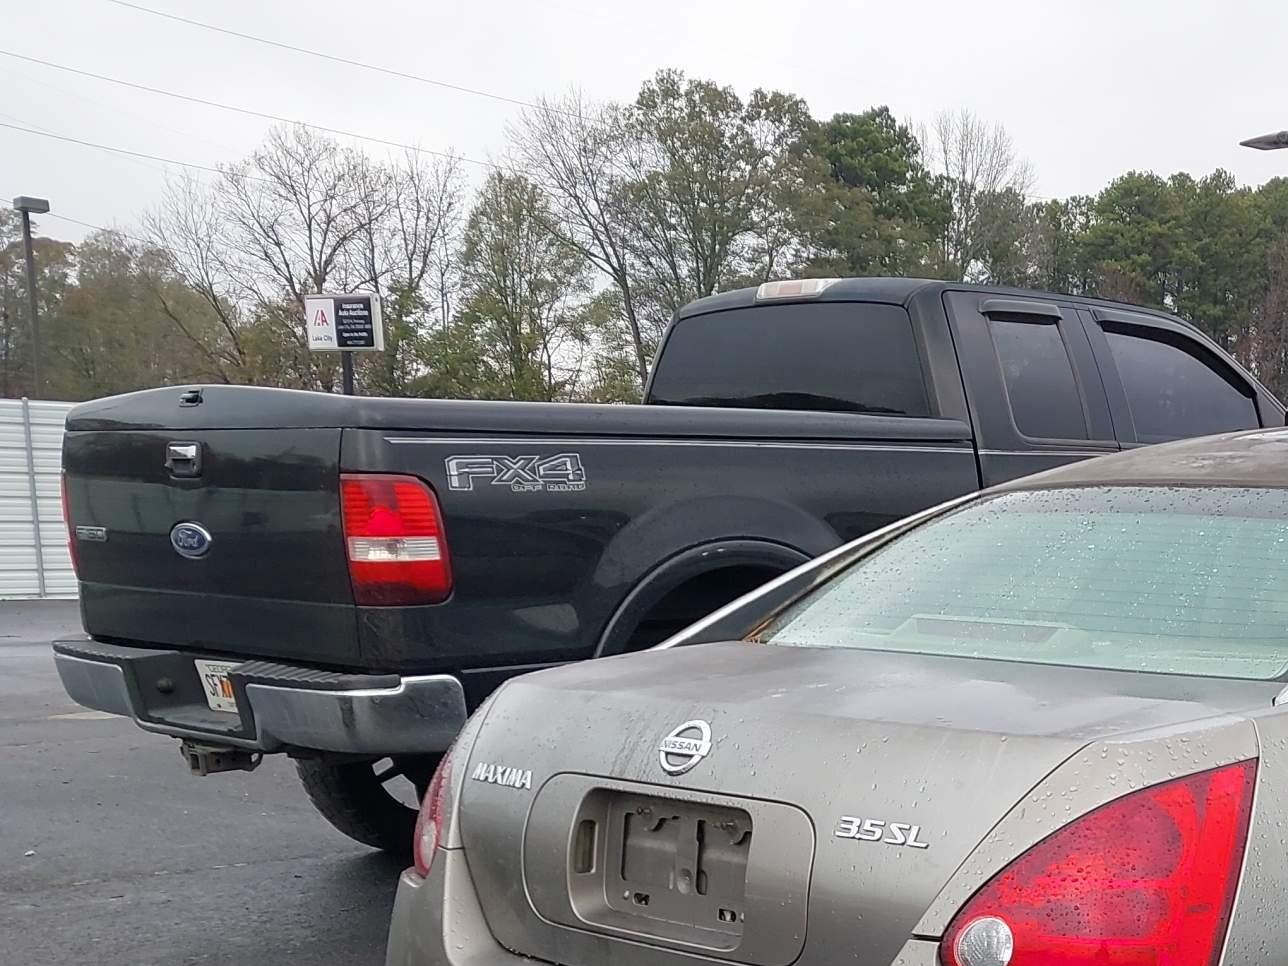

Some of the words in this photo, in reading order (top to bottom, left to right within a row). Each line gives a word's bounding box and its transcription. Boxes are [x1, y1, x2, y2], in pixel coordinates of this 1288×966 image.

[323, 335, 333, 343] City
[444, 453, 586, 491] FX4
[662, 739, 702, 752] NISSAN
[472, 762, 533, 790] MAXIMA
[884, 822, 929, 849] SL
